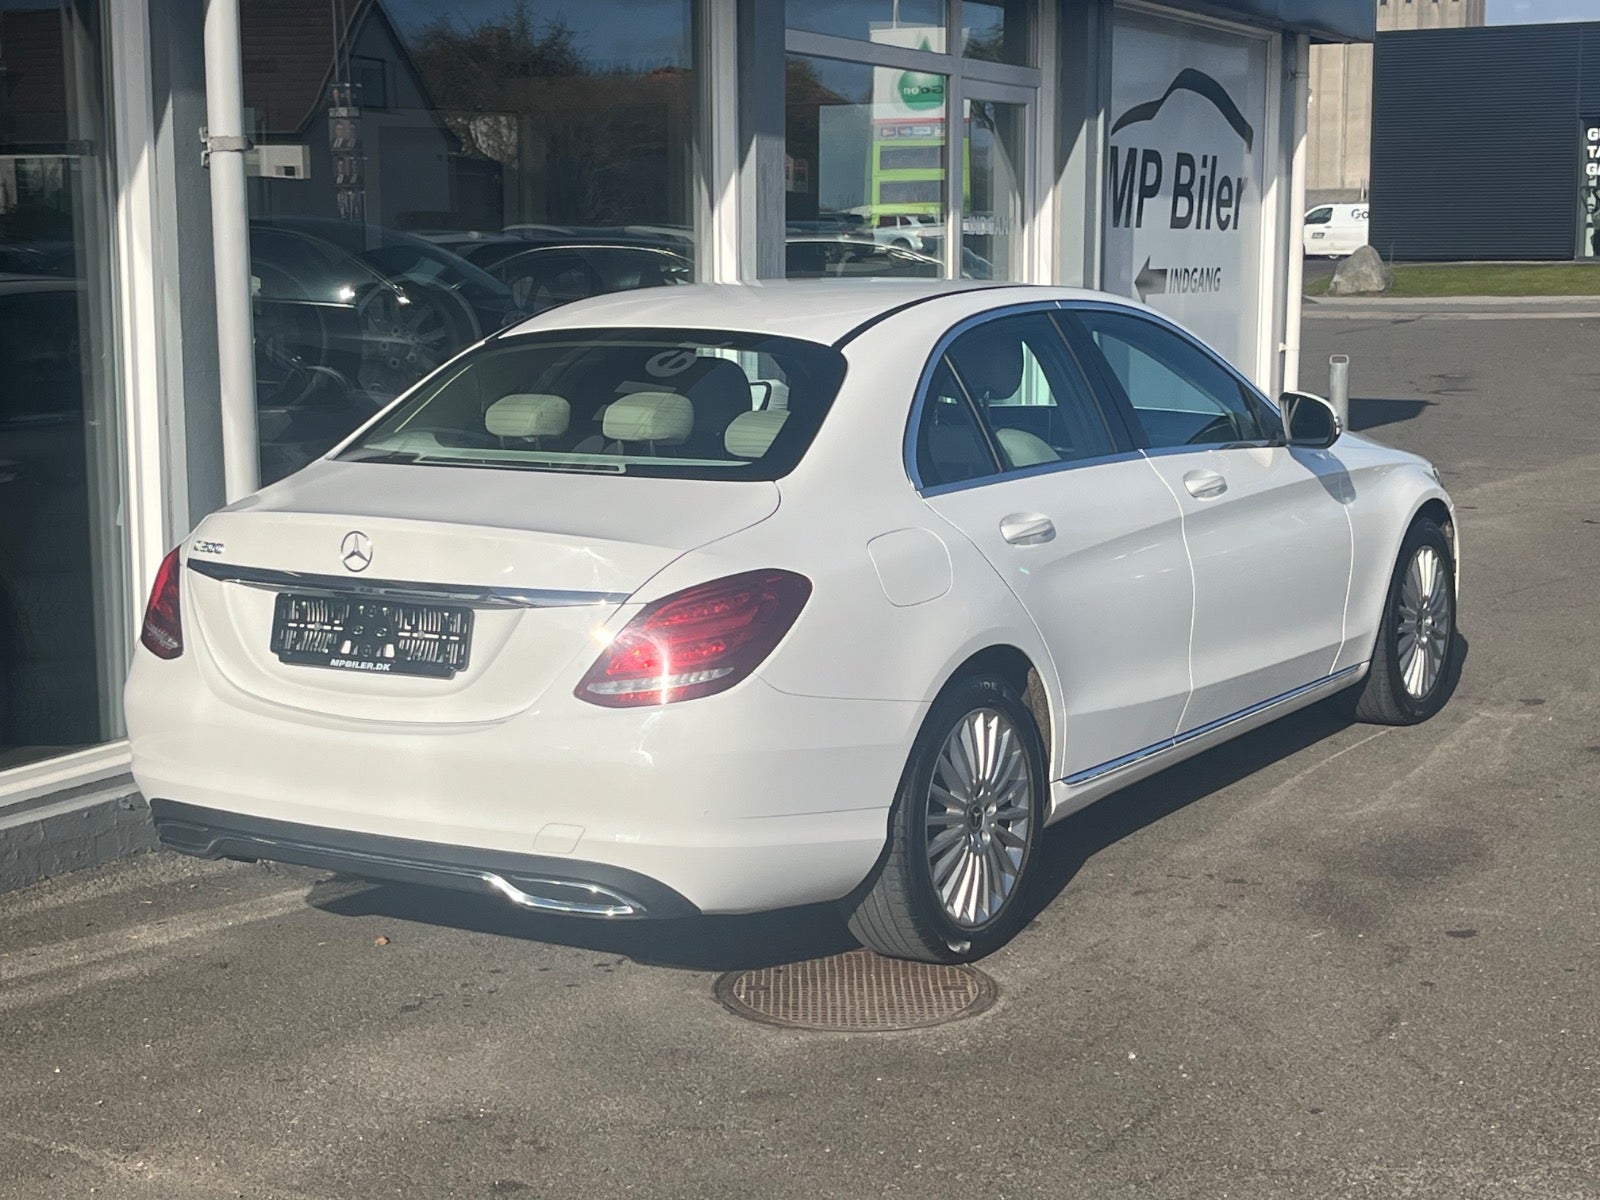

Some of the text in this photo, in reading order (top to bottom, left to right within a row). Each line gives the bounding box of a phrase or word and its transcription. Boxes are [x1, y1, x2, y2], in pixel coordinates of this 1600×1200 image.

[1109, 145, 1248, 232] MP Biler
[1168, 267, 1221, 294] INDGANG
[329, 658, 392, 671] MPBILER.DK
